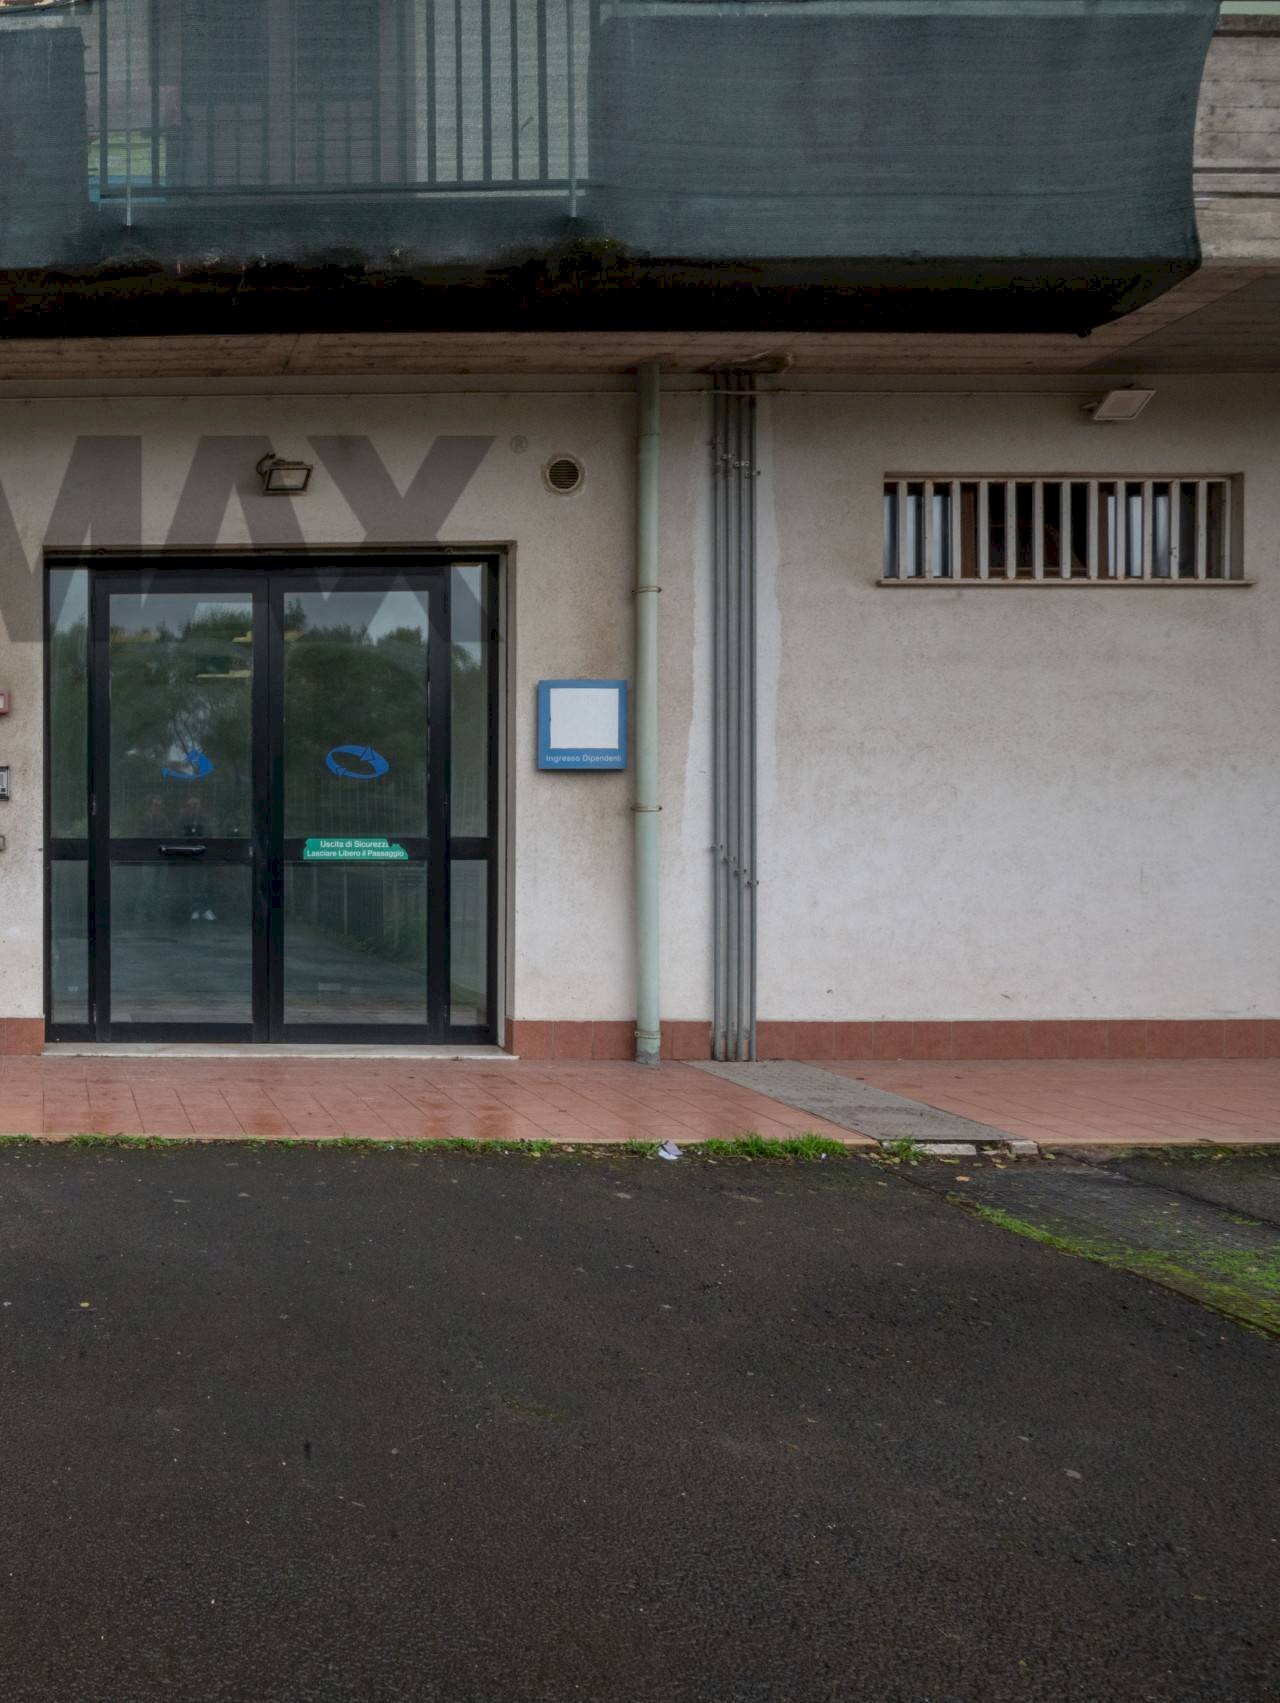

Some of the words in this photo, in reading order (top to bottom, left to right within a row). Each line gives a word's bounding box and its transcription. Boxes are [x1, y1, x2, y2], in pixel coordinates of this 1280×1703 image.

[545, 754, 580, 764] Ingresso
[582, 754, 622, 763] Dipendenti
[320, 840, 343, 848] Uscita
[345, 840, 352, 848] di
[368, 850, 404, 858] Passaggio
